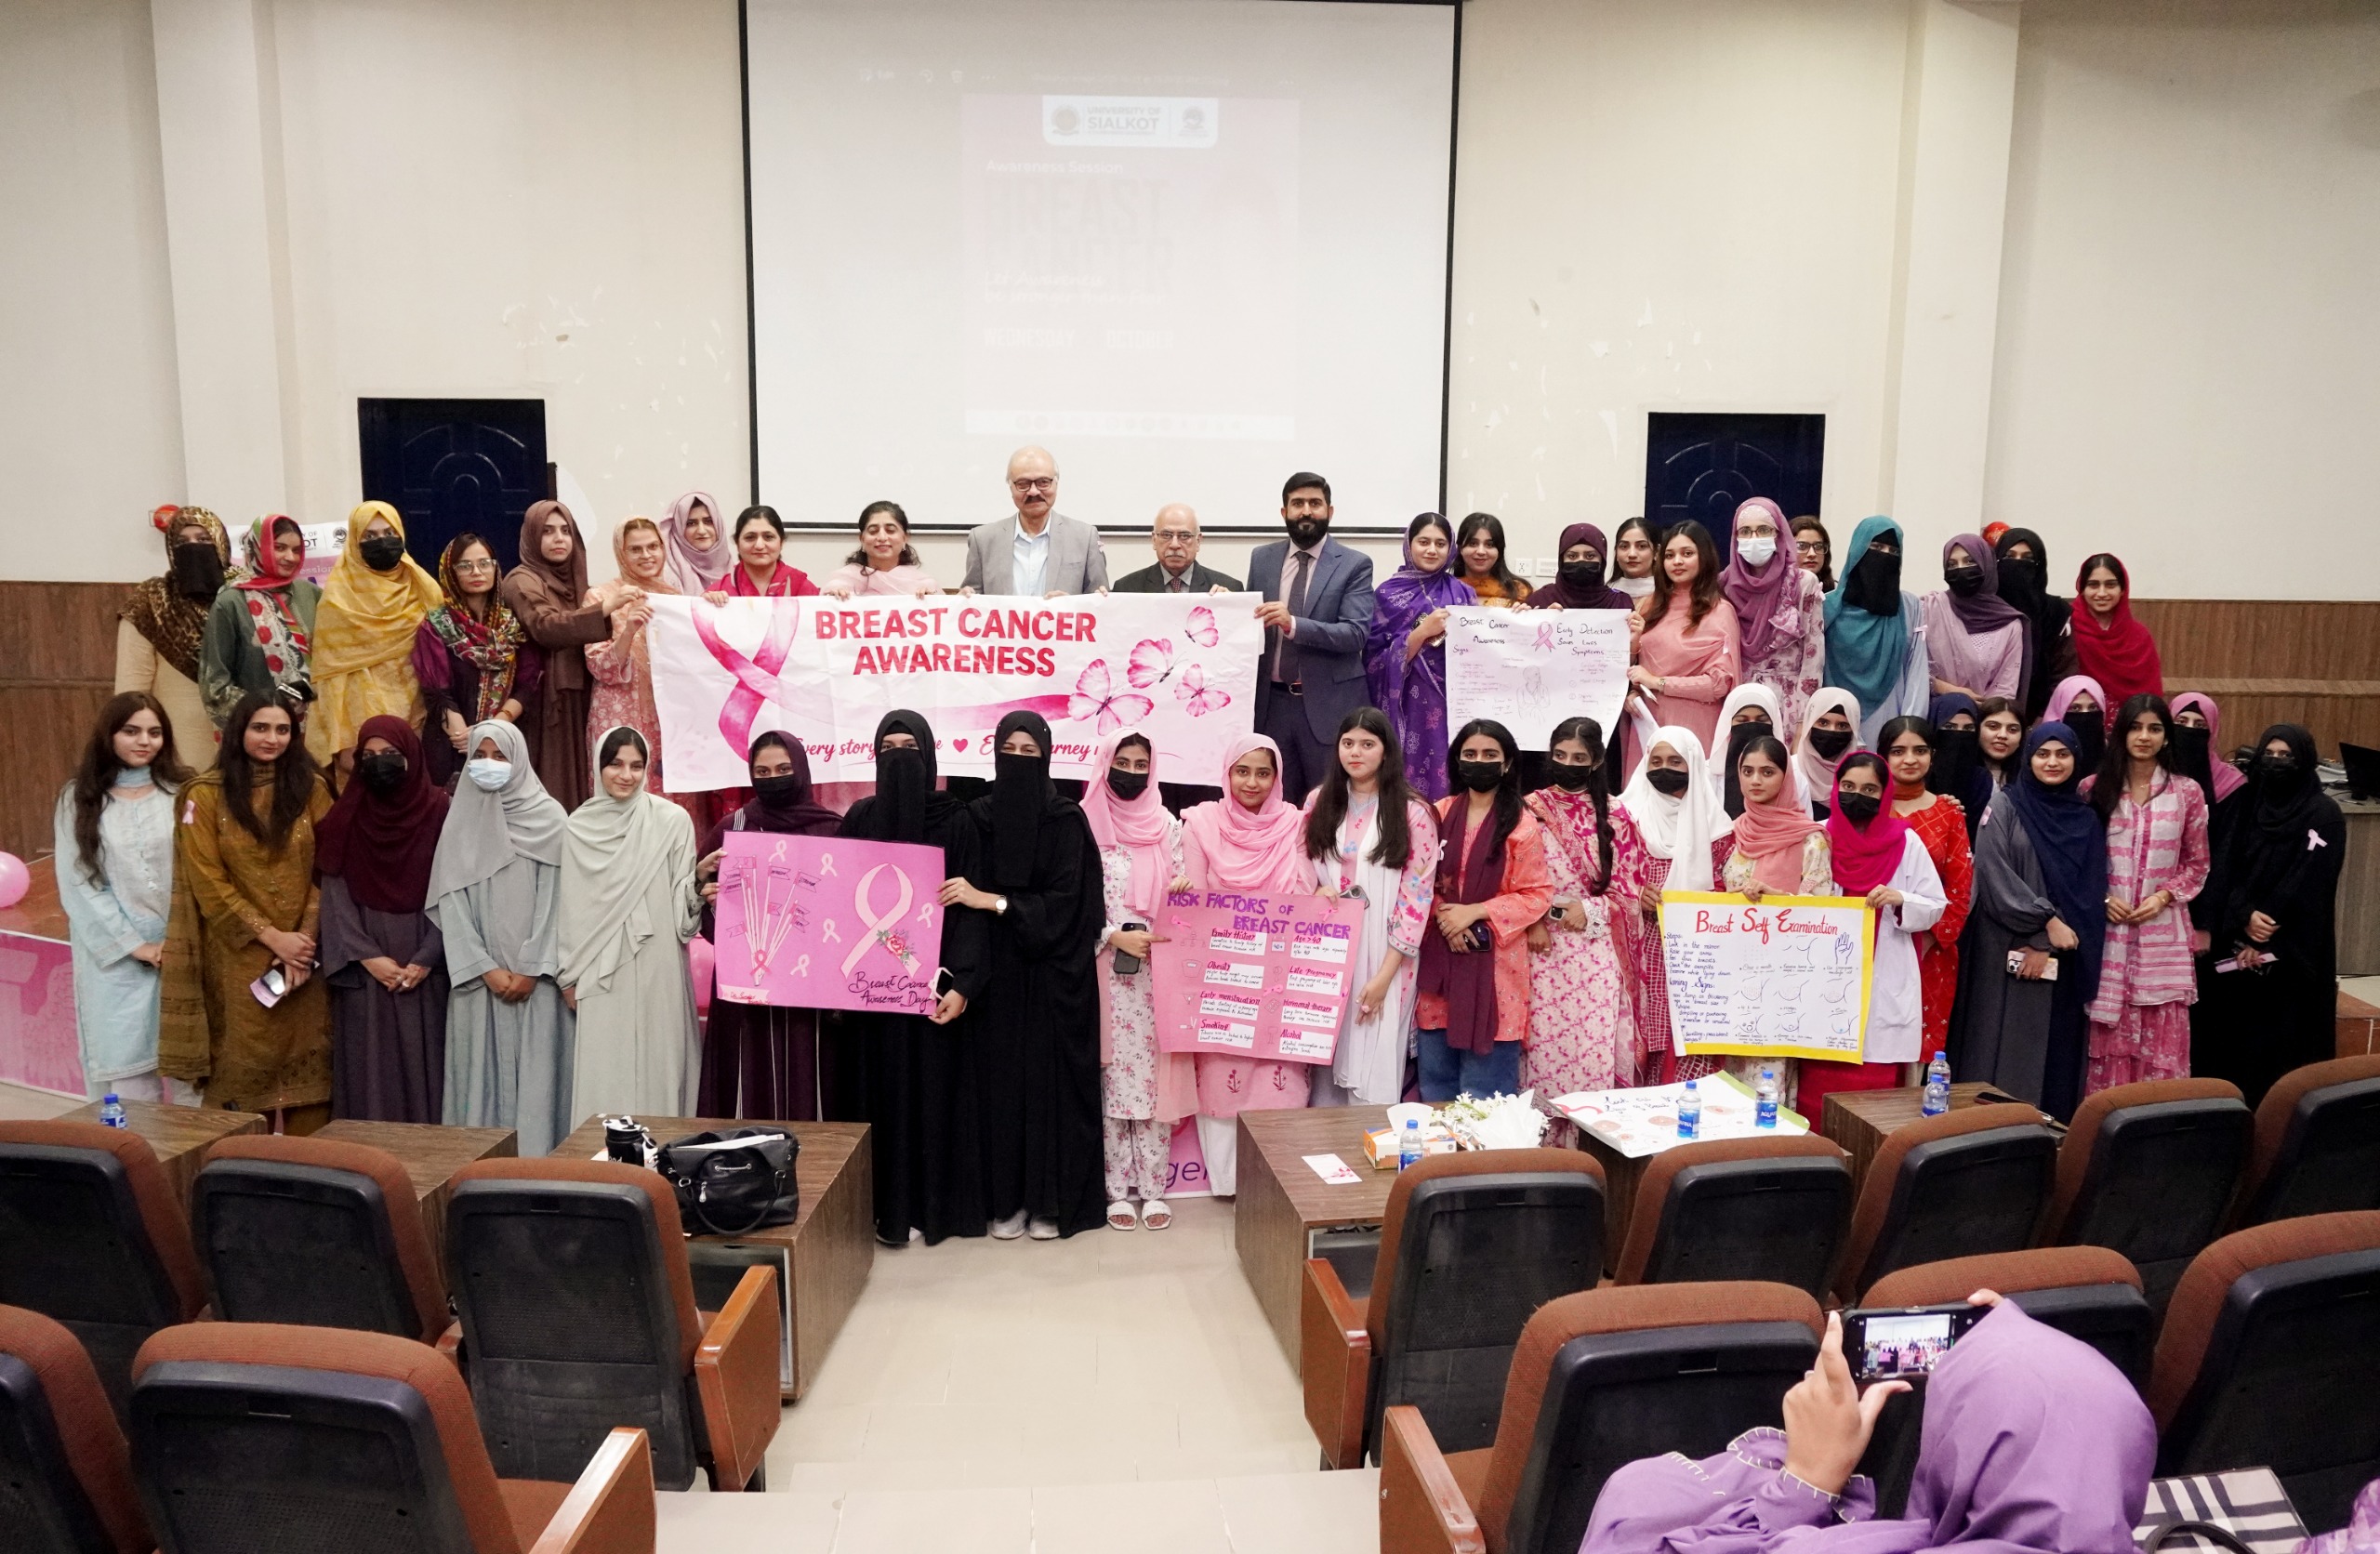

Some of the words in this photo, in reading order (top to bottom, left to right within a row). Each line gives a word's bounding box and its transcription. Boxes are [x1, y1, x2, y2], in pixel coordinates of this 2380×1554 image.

[1088, 106, 1145, 115] UNIVERSITY
[1148, 107, 1161, 115] OF
[1088, 117, 1159, 130] SIALKOT
[985, 160, 1065, 173] Awareness
[1068, 161, 1124, 174] Session
[1015, 270, 1106, 287] Awareness
[984, 328, 1076, 347] WEDNESDAY
[1106, 329, 1174, 349] OCTOBER
[815, 608, 948, 639] BREAST
[958, 608, 1096, 643] CANCER
[1460, 617, 1484, 627] Breast
[1489, 619, 1510, 629] Cancer
[1556, 623, 1573, 637] Early
[1580, 623, 1613, 635] Detection
[1473, 636, 1505, 644] Awareness
[1557, 638, 1574, 646] Saves
[1571, 647, 1605, 657] Symptoms
[853, 643, 1055, 677] AWARENESS
[839, 738, 877, 760] story
[1168, 892, 1200, 907] RISK
[1206, 894, 1269, 915] FACTORS
[1279, 905, 1294, 915] OF
[1233, 915, 1289, 934] BREAST
[1294, 921, 1352, 940] CANCER
[1696, 910, 1734, 934] Breast
[1741, 907, 1771, 945] Self
[1776, 909, 1838, 936] Examination
[1211, 928, 1233, 940] Family
[1234, 930, 1256, 942] History
[1294, 935, 1306, 943] Age
[1692, 941, 1700, 949] the
[1207, 960, 1231, 972] Obesity
[1289, 966, 1303, 975] Late
[848, 971, 897, 994] Breast
[861, 990, 904, 1007] Awareness
[900, 991, 932, 1013] Day
[1200, 991, 1215, 1001] Early
[1218, 993, 1261, 1006] menstruation
[1283, 998, 1310, 1009] Hormonal
[1311, 1001, 1333, 1013] therapy
[1200, 1019, 1230, 1031] Smoking
[1281, 1028, 1302, 1040] Alcohol
